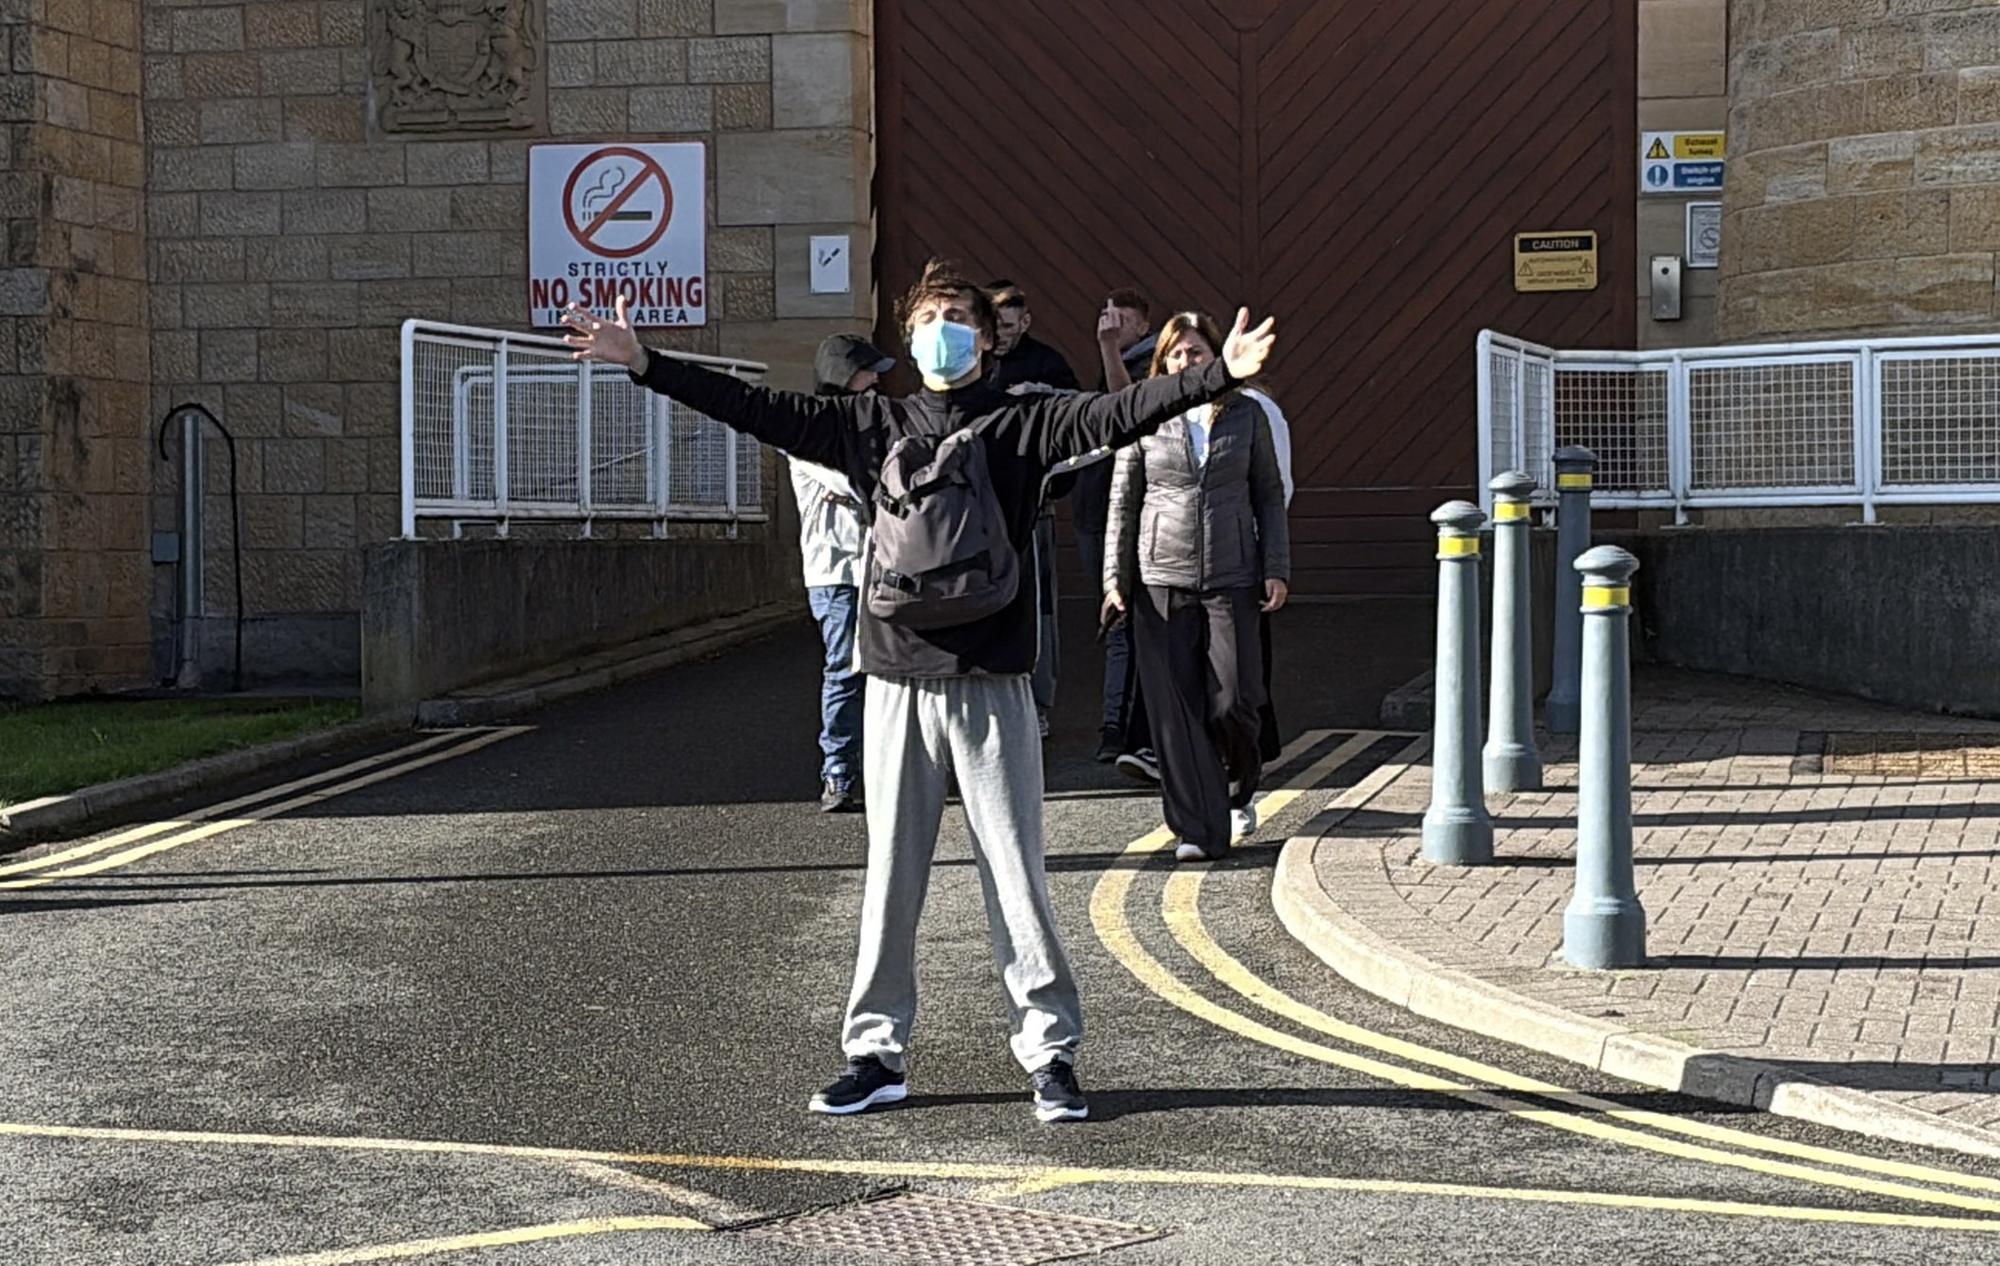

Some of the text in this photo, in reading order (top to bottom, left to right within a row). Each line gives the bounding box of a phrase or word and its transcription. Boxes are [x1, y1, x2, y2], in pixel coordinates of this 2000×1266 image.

[1532, 239, 1579, 250] CAUTION
[568, 261, 668, 277] STRICTLY
[532, 276, 702, 309] NO SMOKING
[634, 309, 688, 324] AREA
